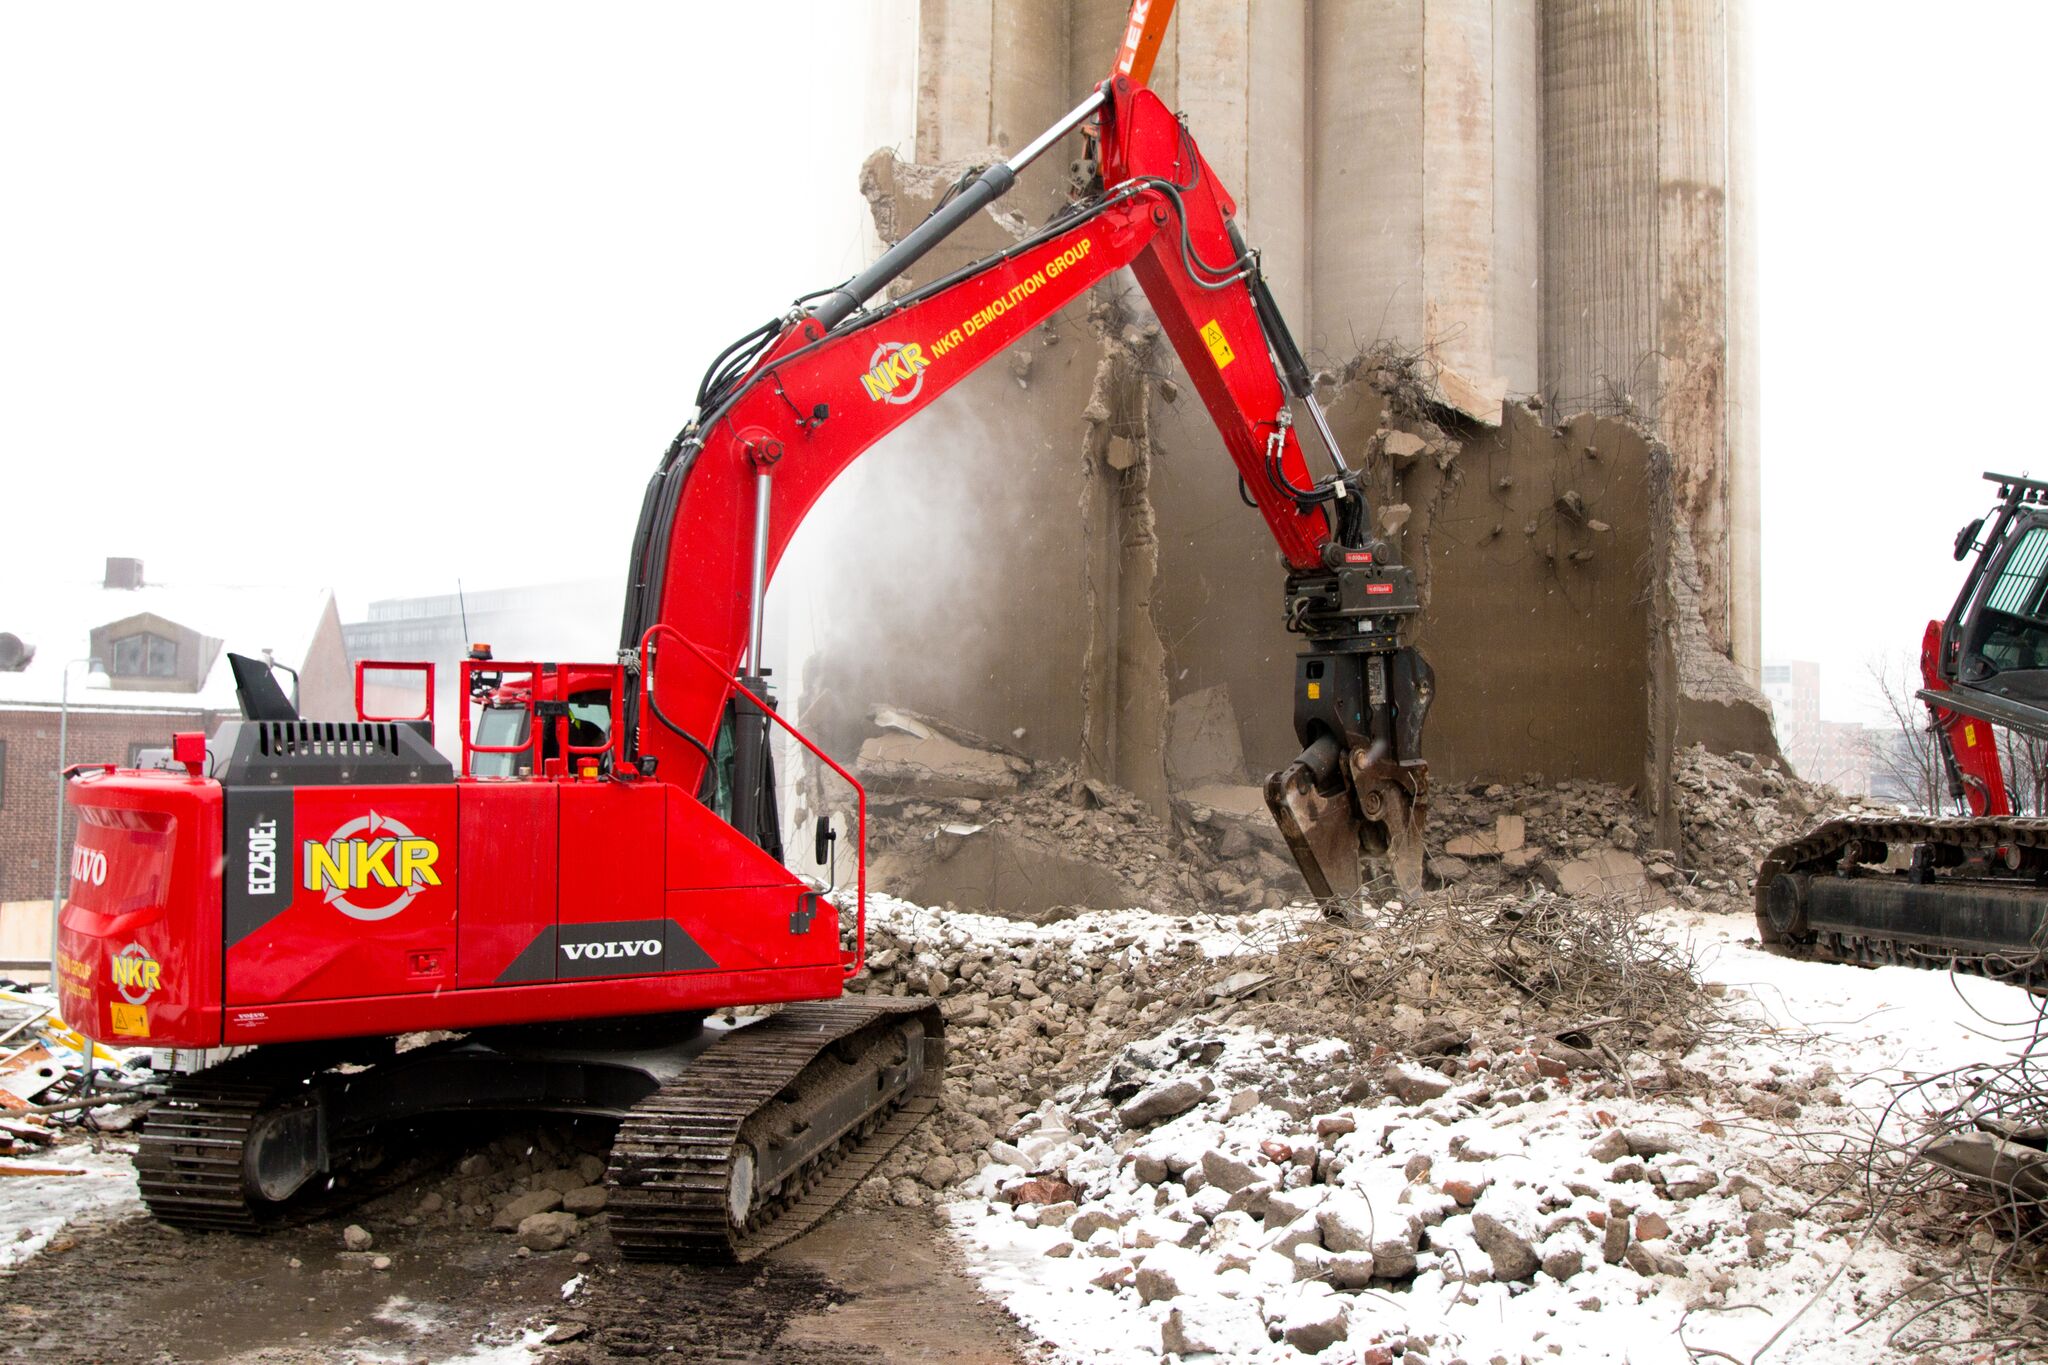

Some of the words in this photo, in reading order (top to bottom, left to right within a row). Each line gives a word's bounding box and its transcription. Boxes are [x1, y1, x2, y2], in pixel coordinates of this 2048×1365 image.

[930, 331, 964, 360] NKR
[963, 271, 1047, 337] DEMOLITION
[1045, 238, 1091, 279] GROUP
[859, 342, 931, 401] NKR
[248, 819, 276, 895] EC250EL
[303, 836, 442, 891] NKR
[112, 953, 161, 990] NKR
[560, 939, 662, 960] VOLVO
